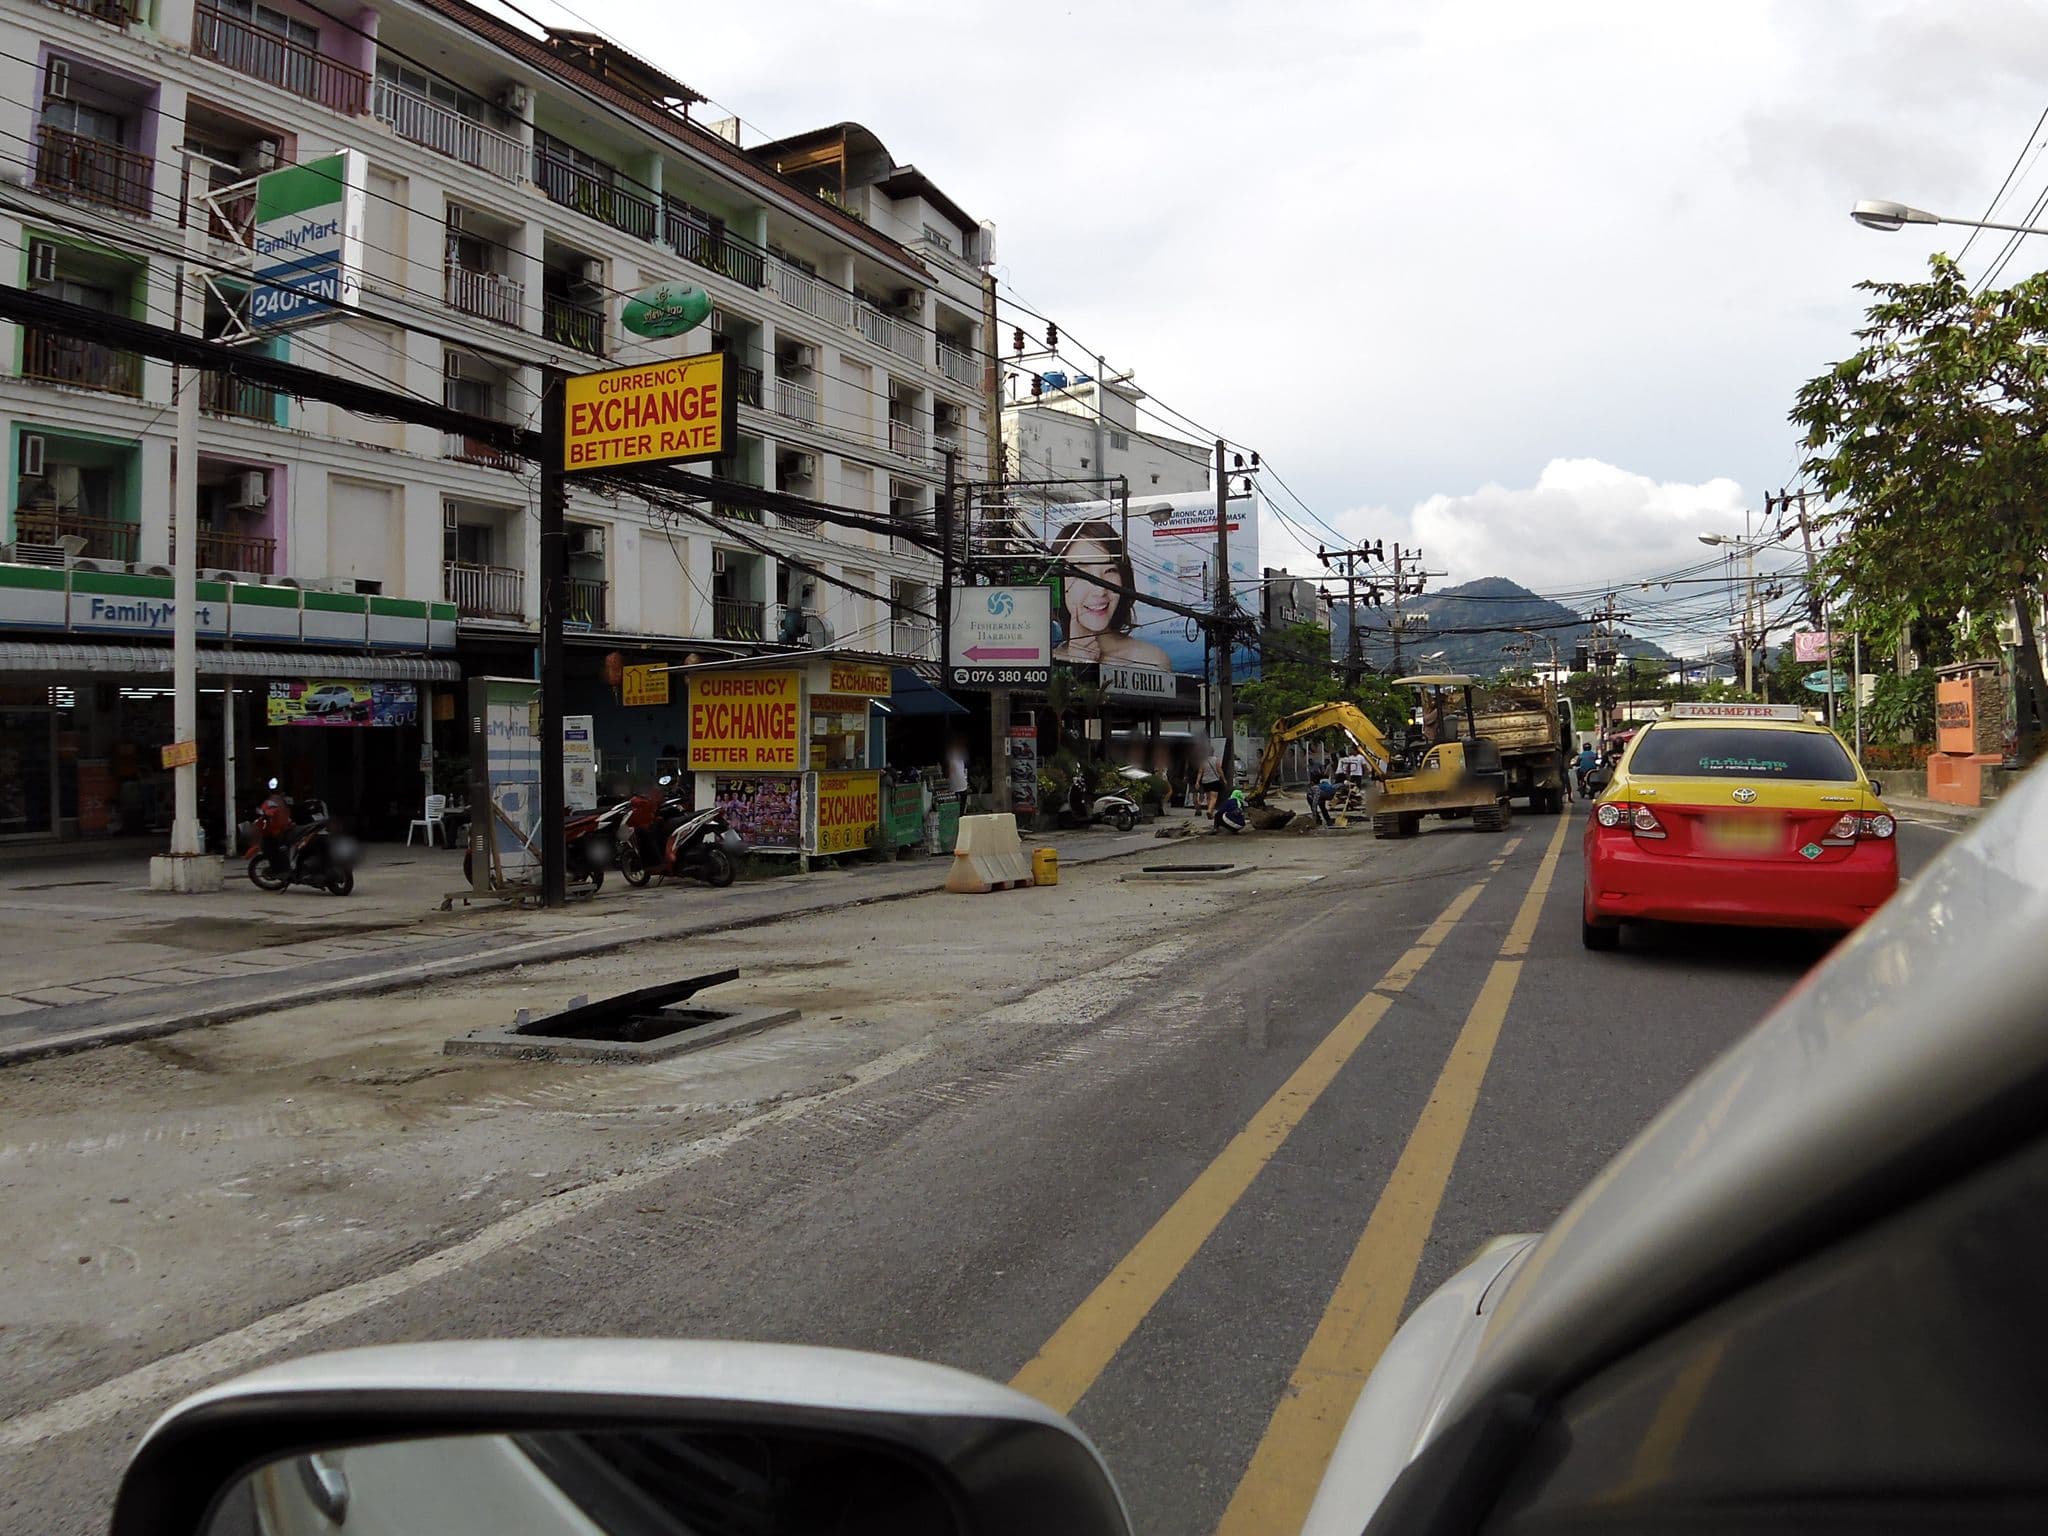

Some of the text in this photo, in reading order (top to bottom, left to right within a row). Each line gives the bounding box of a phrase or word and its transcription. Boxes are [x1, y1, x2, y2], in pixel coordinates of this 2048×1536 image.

[256, 219, 338, 256] FamilyMart
[599, 367, 688, 394] CURRENCY
[571, 384, 717, 436] EXCHANGE
[570, 425, 717, 464] BETTER RATE
[1169, 515, 1208, 526] WHITENING
[1198, 508, 1215, 517] ACID
[970, 621, 1031, 631] FISHERMEN'S
[831, 673, 889, 692] EXCHANGE
[971, 671, 1047, 682] 076 380 400
[1114, 670, 1165, 693] LE GRILL
[700, 678, 786, 696] CURRENCY
[1689, 706, 1773, 717] TAXI-METER
[692, 703, 796, 740] EXCHANGE
[692, 747, 794, 762] BETTER RATE
[821, 778, 849, 791] CURRENCY
[820, 793, 877, 827] EXCHANGE
